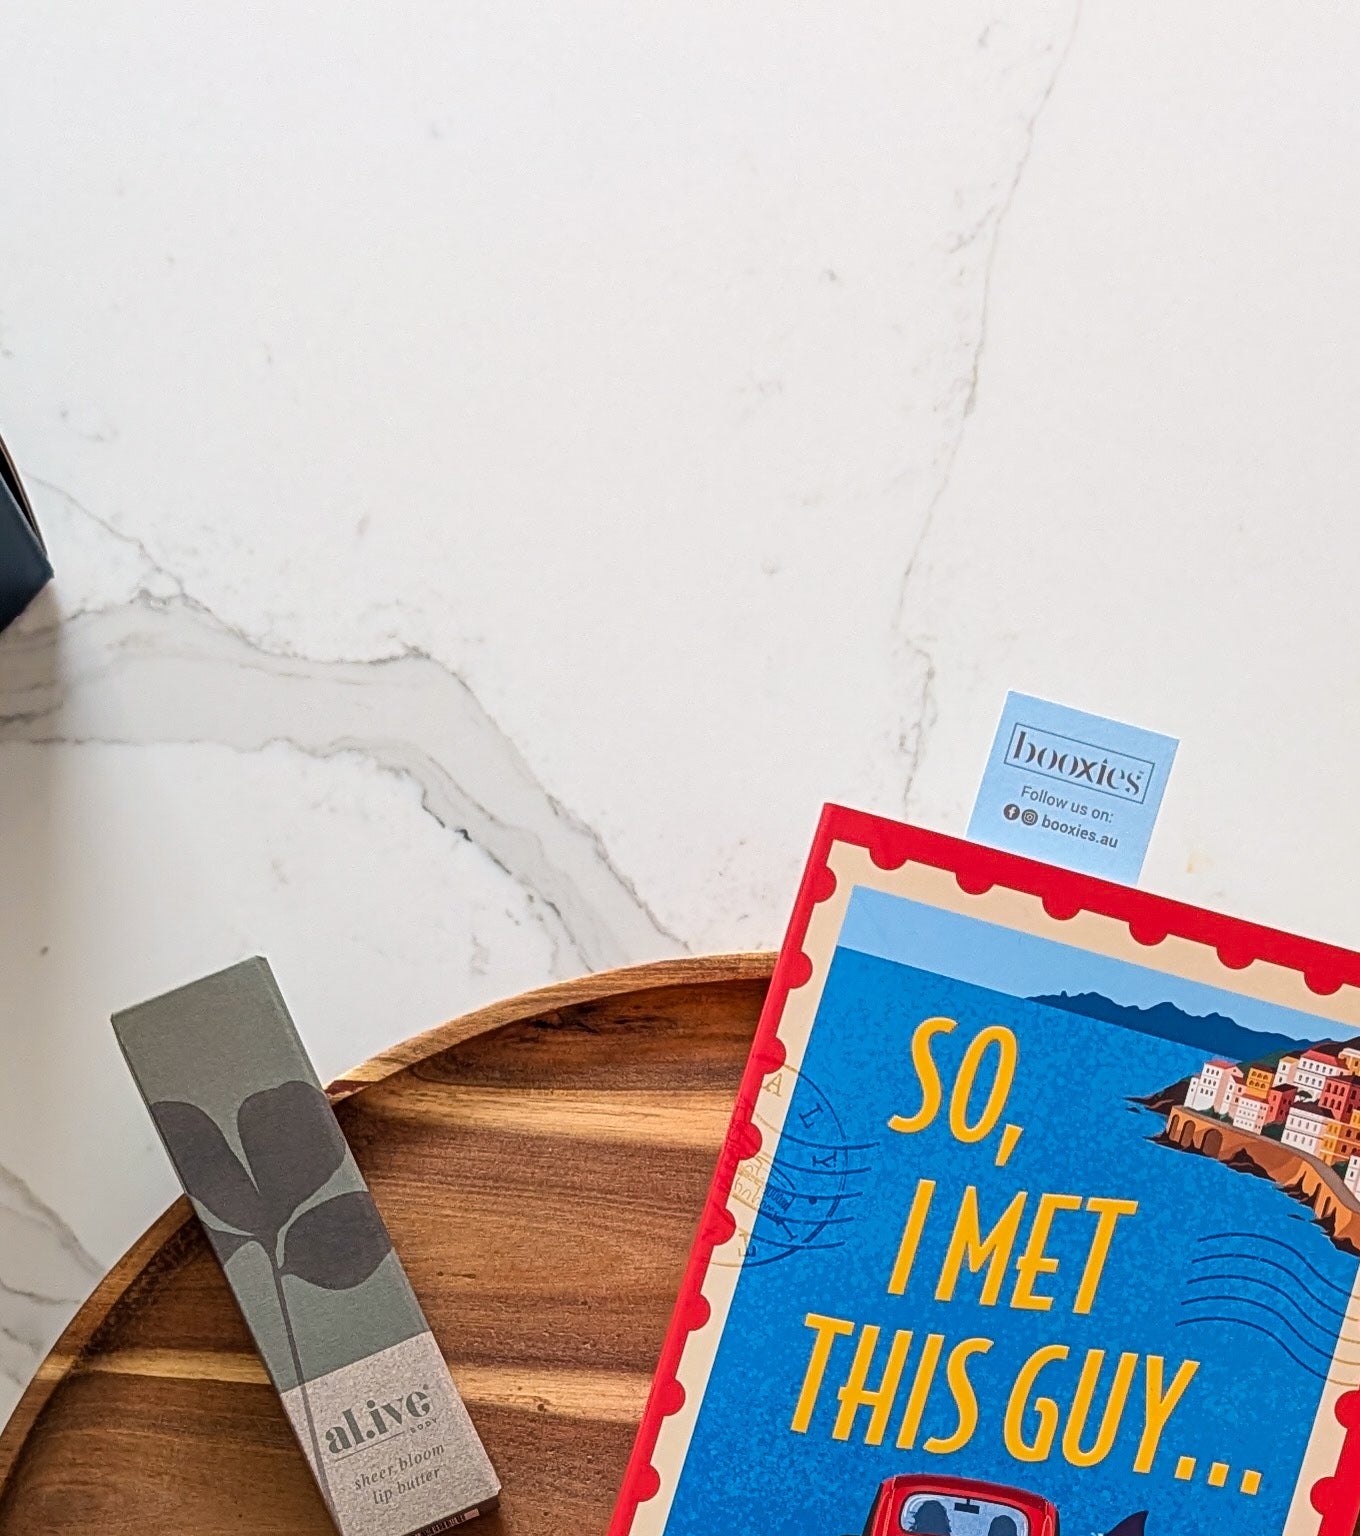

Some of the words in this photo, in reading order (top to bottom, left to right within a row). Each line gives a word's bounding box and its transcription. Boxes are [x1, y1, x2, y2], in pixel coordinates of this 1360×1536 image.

[1013, 730, 1143, 796] booxies
[1021, 785, 1068, 810] Follow
[1070, 798, 1088, 816] us
[1092, 807, 1114, 824] on:
[1042, 814, 1119, 849] booxies.au
[888, 1016, 1024, 1168] SO,
[888, 1179, 937, 1296] I
[935, 1186, 1138, 1315] MET
[326, 1391, 430, 1454] al.ive
[790, 1313, 994, 1454] THIS
[1003, 1344, 1263, 1496] GUY...
[354, 1464, 393, 1490] sheer
[399, 1444, 445, 1472] bloom
[373, 1489, 392, 1505] lip
[397, 1467, 440, 1495] butter
